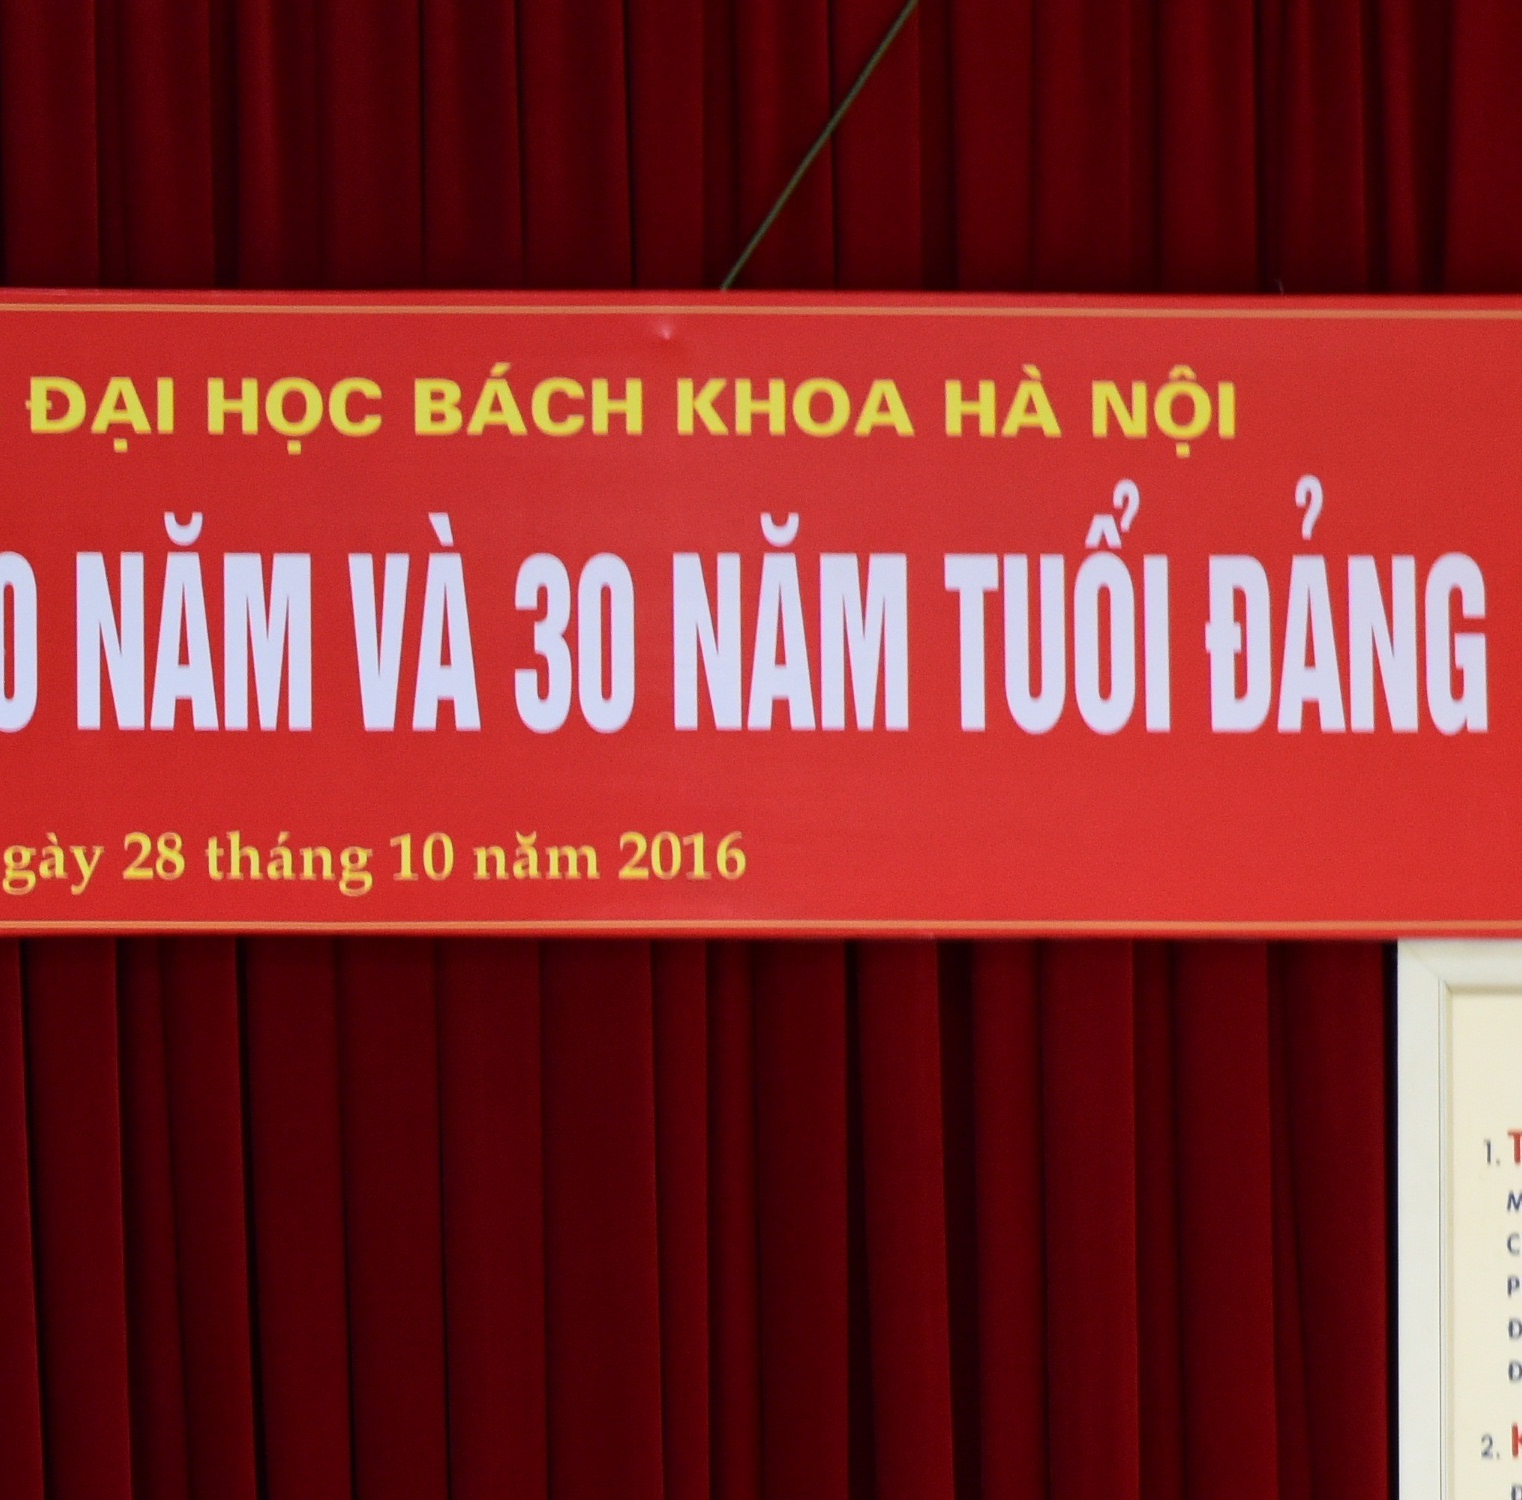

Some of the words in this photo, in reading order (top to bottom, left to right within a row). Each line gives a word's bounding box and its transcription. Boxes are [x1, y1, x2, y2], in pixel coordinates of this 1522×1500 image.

[27, 377, 174, 452] ĐẠI
[208, 378, 381, 454] HỌC
[415, 363, 642, 437] BÁCH
[678, 379, 914, 437] KHOA
[946, 365, 1061, 438] HÀ
[1093, 366, 1236, 457] NỘI
[77, 513, 312, 730] NĂM
[349, 513, 480, 731] VÀ
[515, 553, 635, 733] 30
[673, 513, 908, 731] NĂM
[945, 480, 1170, 734] TUỔI
[1206, 476, 1488, 734] ĐẢNG
[122, 831, 186, 880] 28
[205, 830, 372, 897] tháng
[390, 832, 455, 881] 10
[473, 831, 600, 880] năm
[618, 831, 747, 880] 2016
